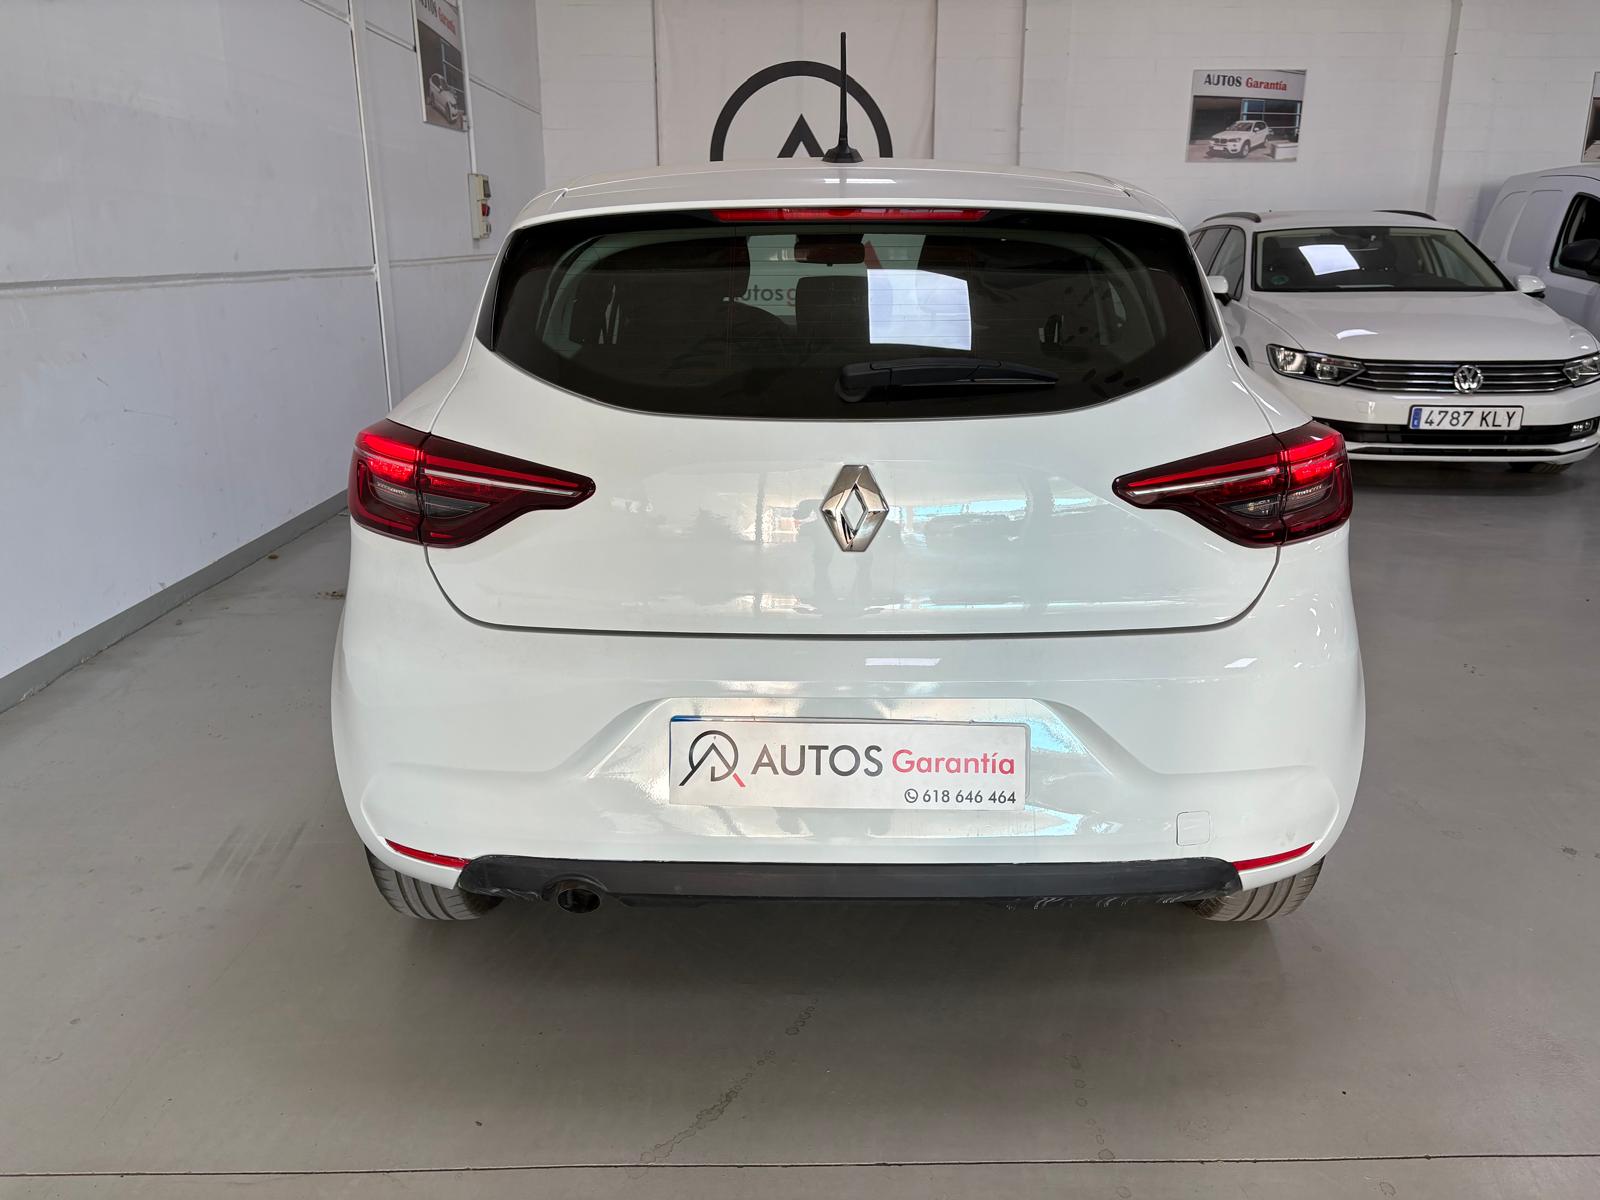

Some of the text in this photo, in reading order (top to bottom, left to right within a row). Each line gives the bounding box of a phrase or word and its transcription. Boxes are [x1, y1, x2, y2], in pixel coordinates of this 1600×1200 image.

[1204, 73, 1287, 91] AUTOS Garantía
[1424, 410, 1474, 427] 4787
[1479, 411, 1517, 427] KLY
[751, 744, 1015, 777] AUTOS Garantía
[923, 790, 1017, 804] 618 646 464
